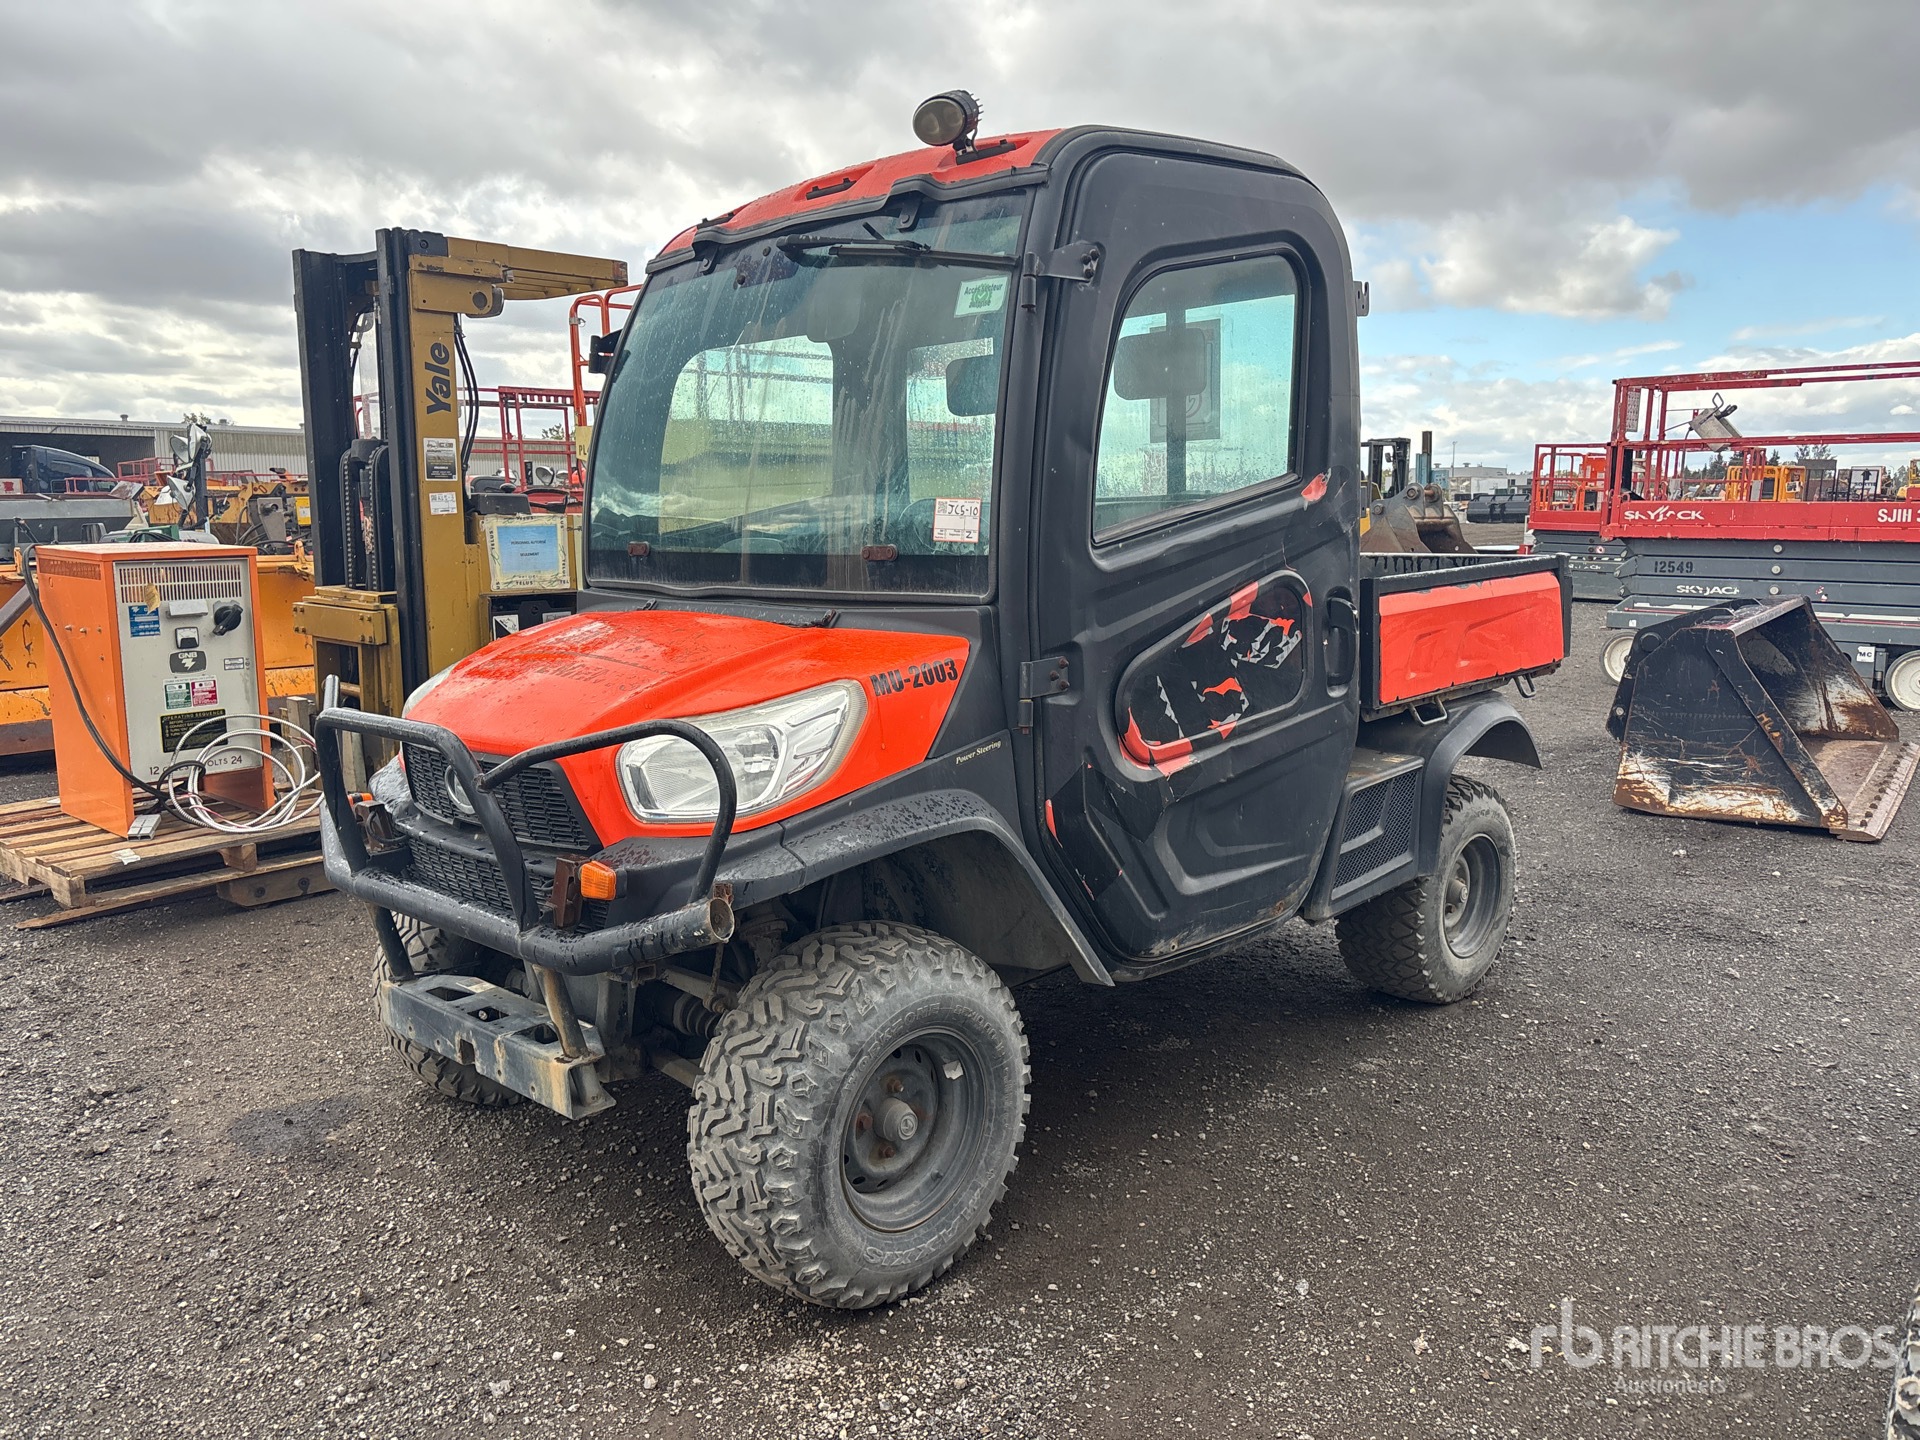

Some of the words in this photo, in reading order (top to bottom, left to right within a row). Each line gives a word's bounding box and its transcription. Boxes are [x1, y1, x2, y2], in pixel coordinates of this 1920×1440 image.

[425, 342, 452, 415] Yale
[578, 445, 589, 455] PL
[1654, 561, 1693, 573] 12549
[178, 651, 197, 659] GNB
[869, 658, 959, 697] MU-2003
[163, 712, 194, 720] OPERATING
[195, 710, 224, 718] SEQUENCE
[956, 751, 976, 764] Power
[976, 741, 1001, 756] Steering
[149, 767, 160, 775] 12
[203, 757, 228, 767] OLTS
[231, 755, 243, 765] 24
